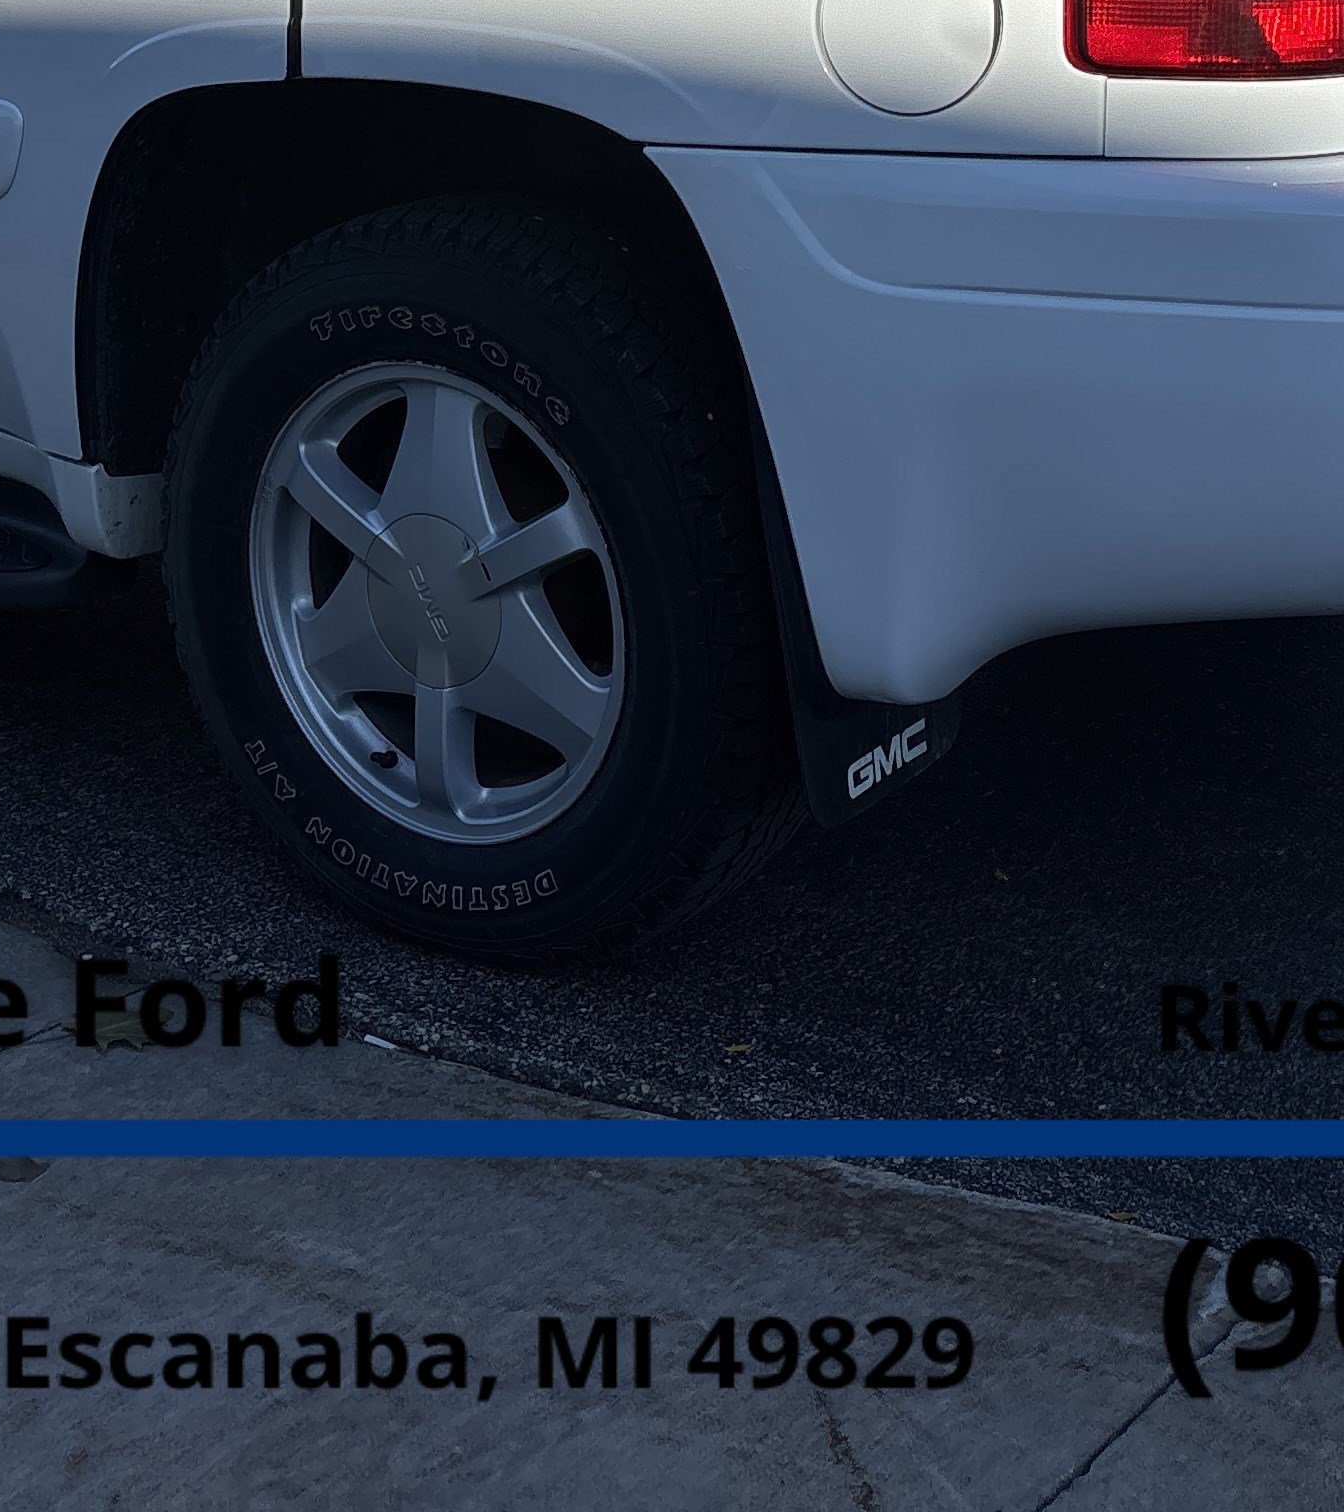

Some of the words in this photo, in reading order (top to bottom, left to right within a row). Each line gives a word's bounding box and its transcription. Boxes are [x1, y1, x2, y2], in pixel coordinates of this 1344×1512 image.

[409, 563, 451, 643] GMC
[244, 739, 297, 801] A/T
[847, 718, 929, 801] GMC
[304, 817, 559, 911] DESTINATION
